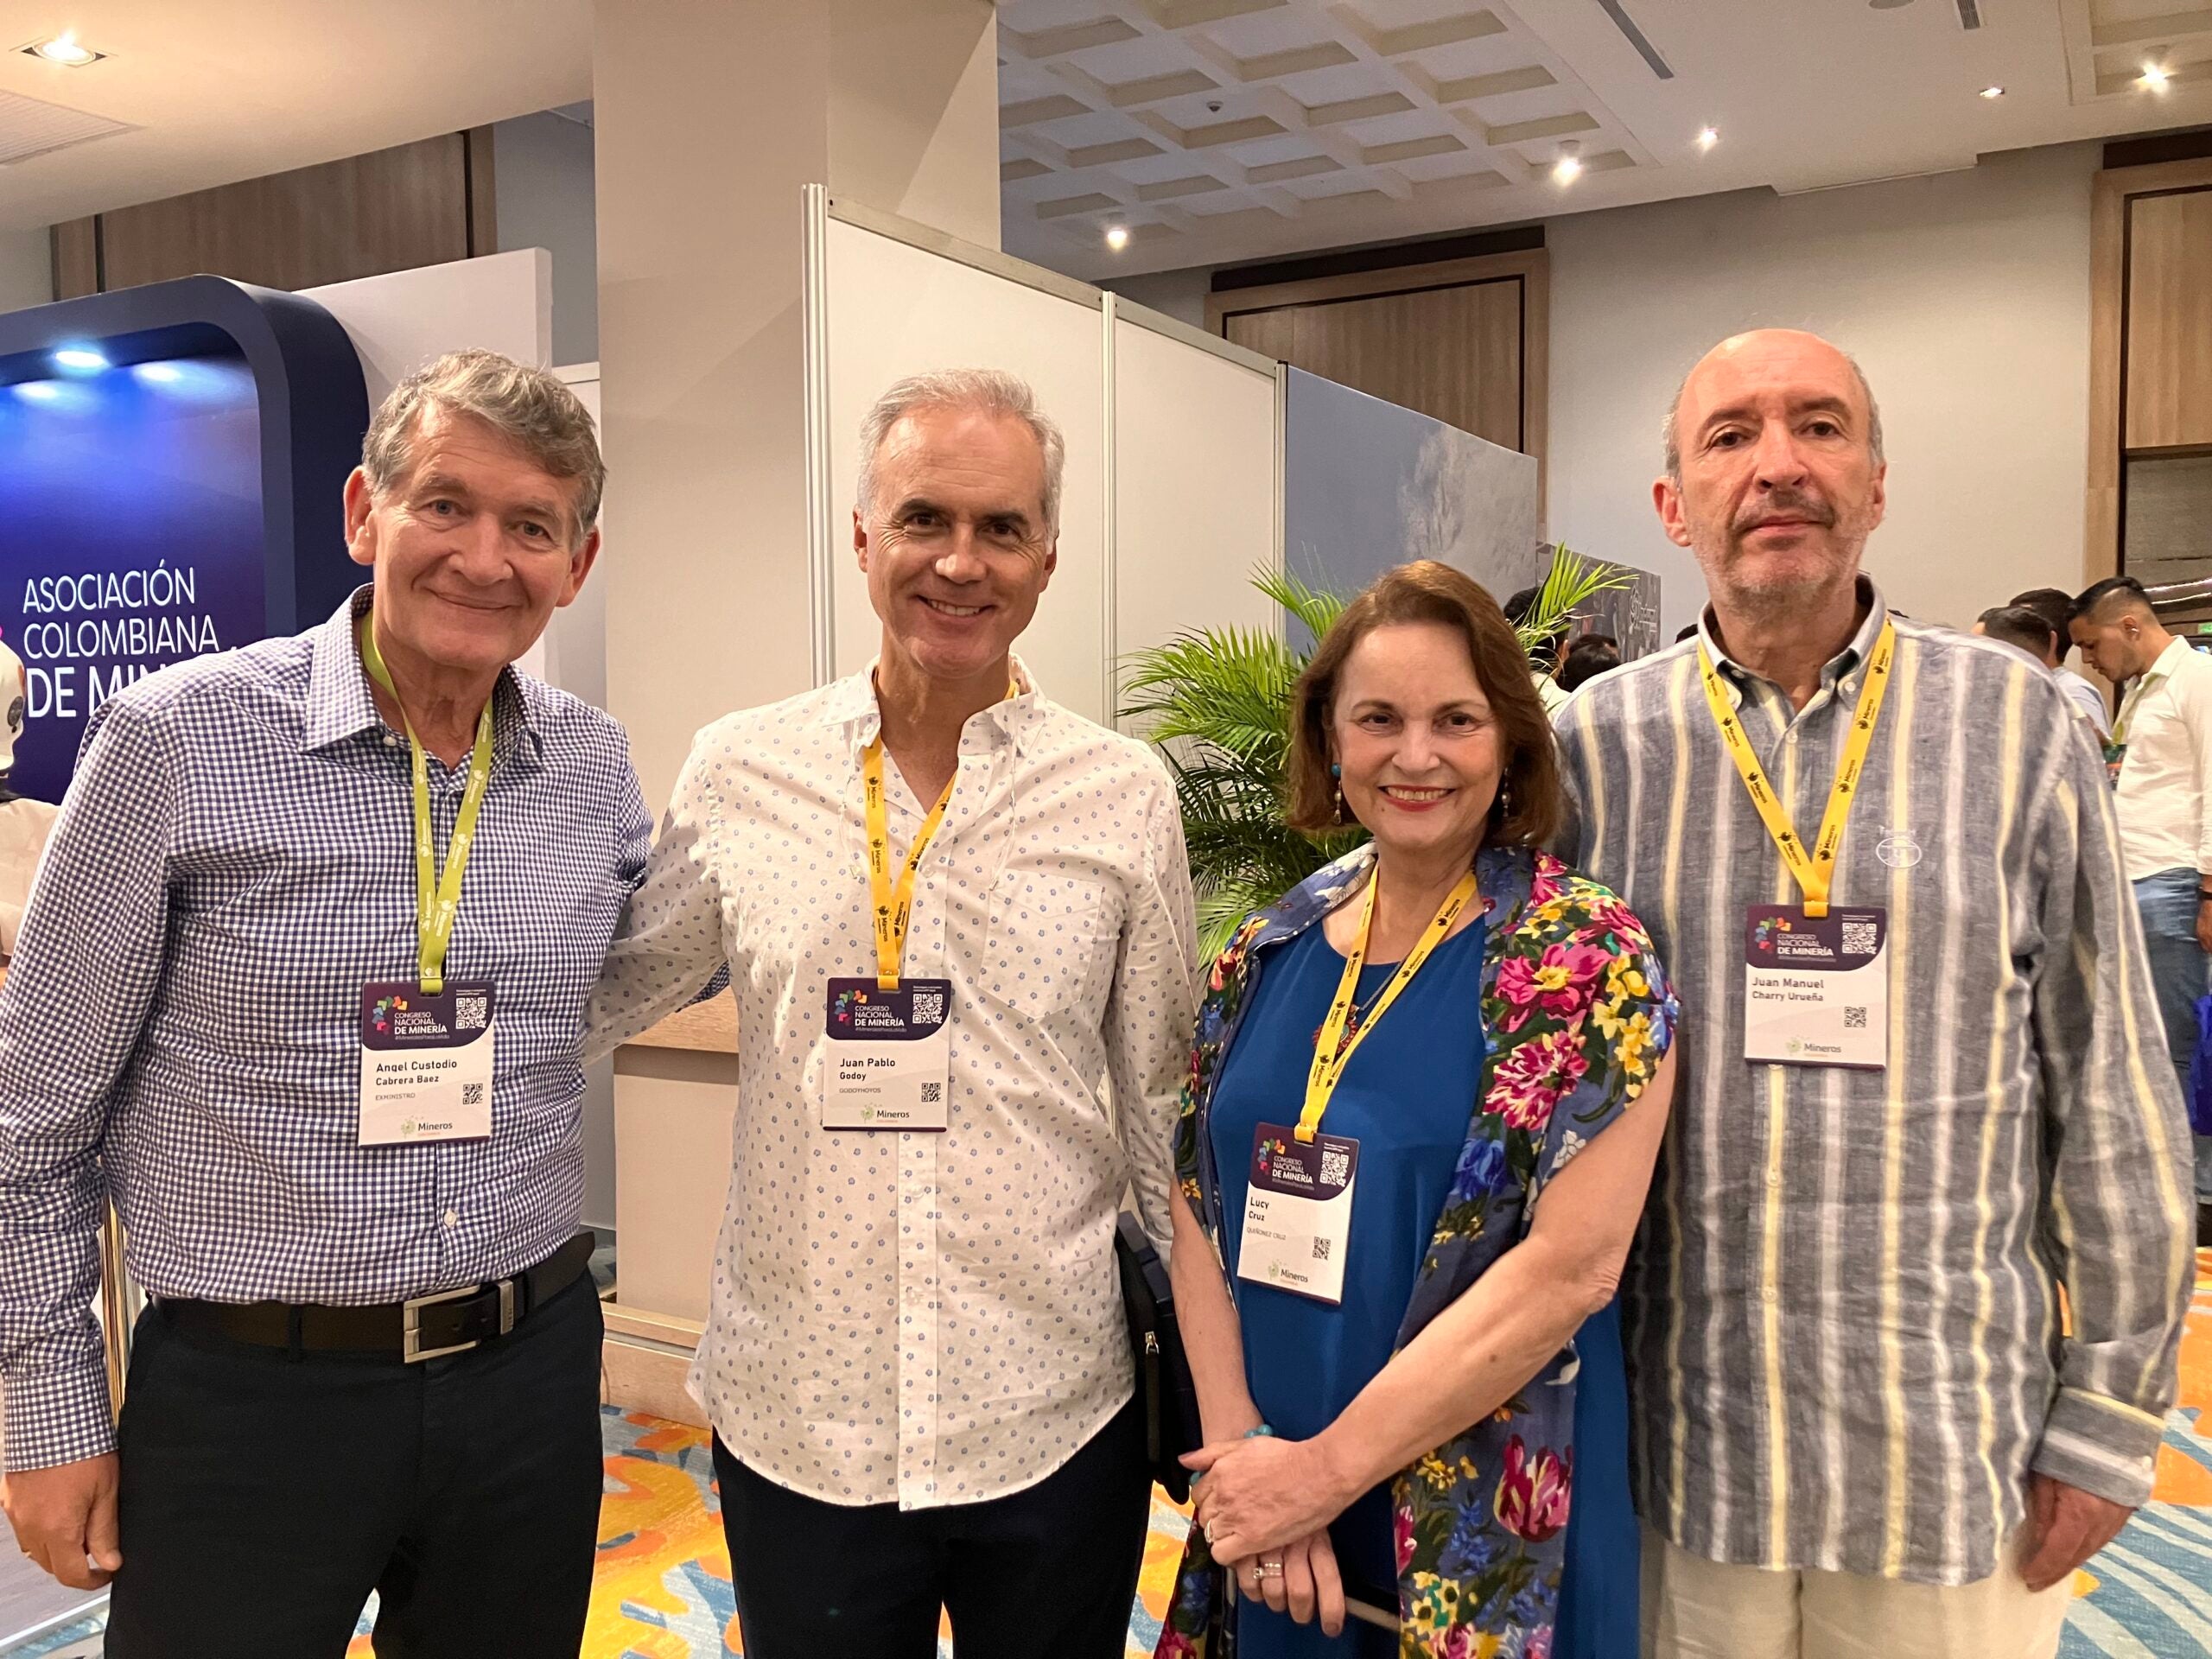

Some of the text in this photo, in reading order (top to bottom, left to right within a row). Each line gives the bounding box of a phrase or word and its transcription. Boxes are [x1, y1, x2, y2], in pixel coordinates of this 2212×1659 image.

[23, 559, 195, 613] ASOCIACIÓN
[24, 614, 219, 659] COLOMBIANA
[26, 666, 76, 718] DE
[893, 901, 904, 925] Mineros
[1792, 945, 1834, 957] MINERÍA
[1752, 977, 1824, 988] Juan Manuel
[1752, 991, 1823, 1001] Charry Urueña
[868, 1016, 905, 1027] MINERÍA
[409, 1023, 448, 1034] MINERÍA
[1804, 1043, 1841, 1052] Mineros
[376, 1059, 457, 1072] Angel Custodio
[840, 1058, 896, 1067] Juan Pablo
[376, 1075, 439, 1086] Cabrera Baez
[840, 1071, 867, 1081] Godoy
[876, 1109, 910, 1118] Mineros
[417, 1122, 453, 1131] Mineros
[1273, 1161, 1304, 1174] NACIONAL
[1272, 1169, 1313, 1184] DE MINERÍA
[1250, 1197, 1269, 1210] Lucy
[1249, 1211, 1265, 1222] Cruz
[1281, 1268, 1308, 1283] Mineros
